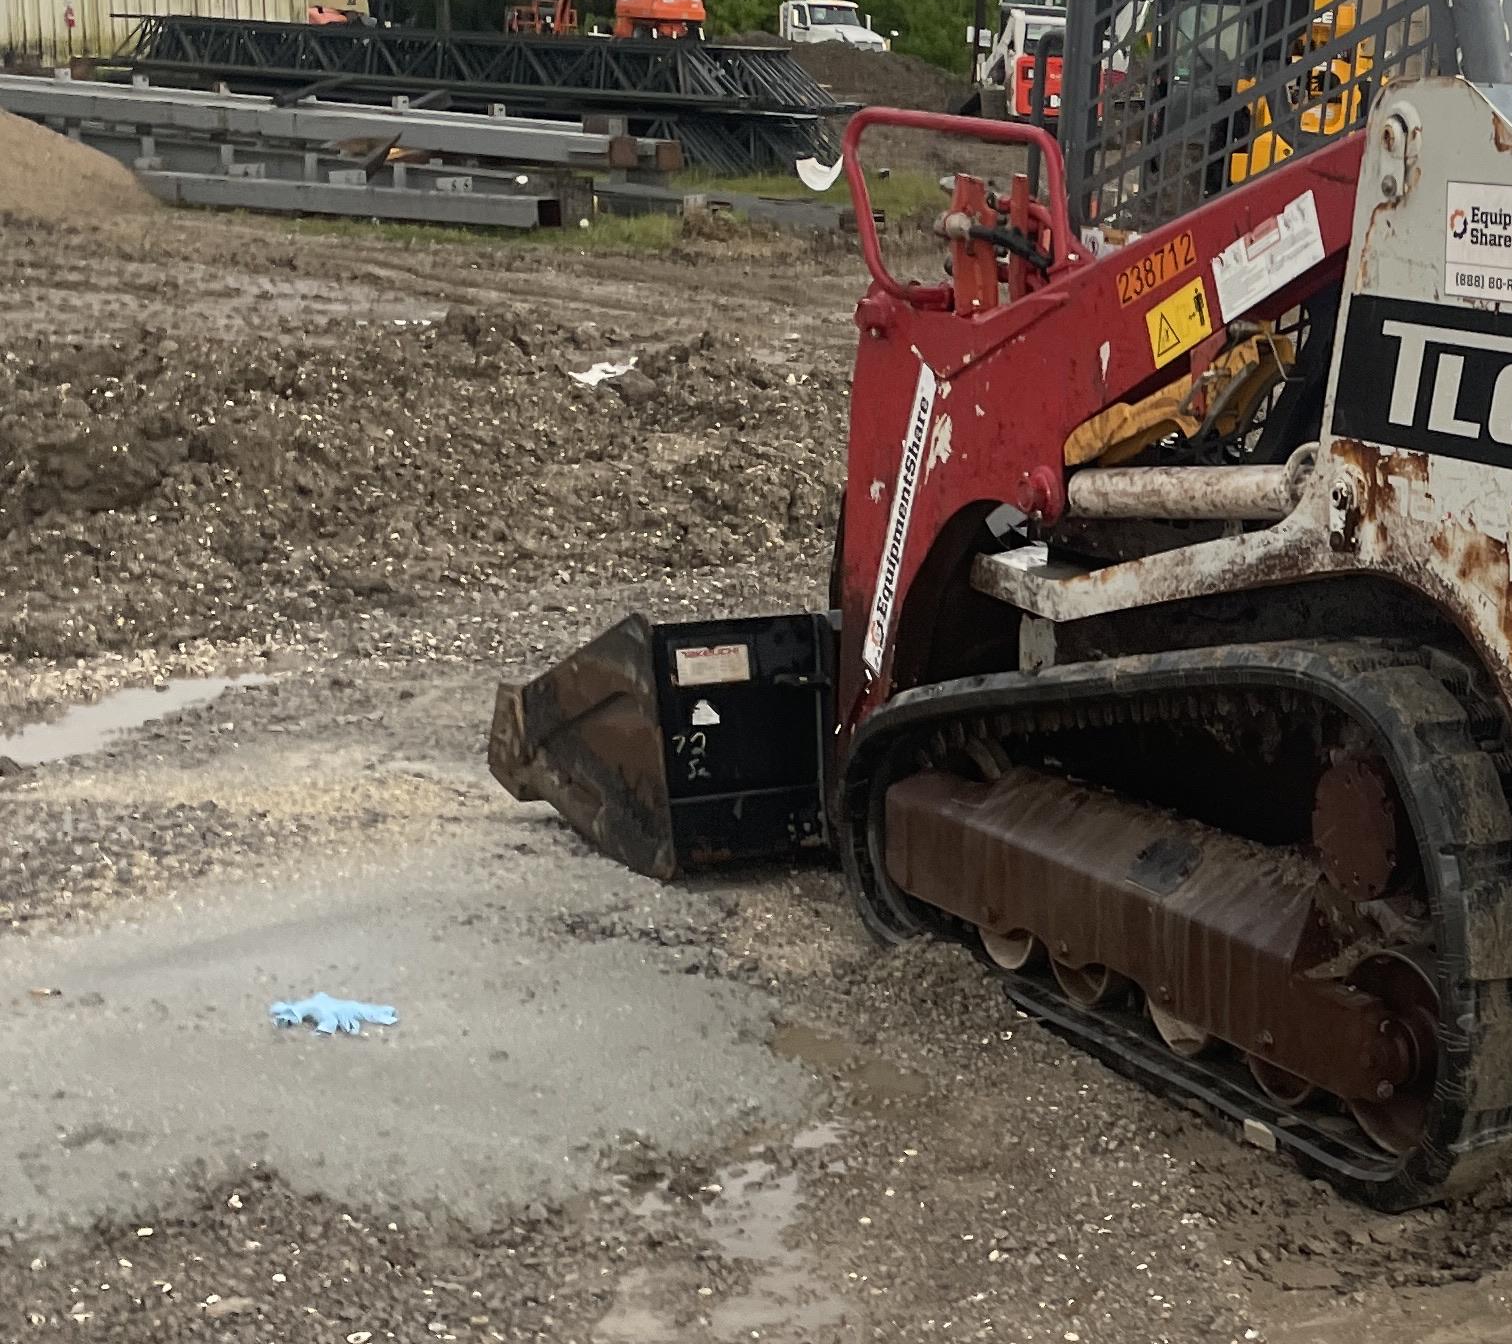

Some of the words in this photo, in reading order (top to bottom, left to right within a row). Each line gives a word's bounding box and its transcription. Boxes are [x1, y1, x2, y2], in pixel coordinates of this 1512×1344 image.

[1470, 228, 1512, 248] Share
[1118, 233, 1196, 304] 238712
[1455, 271, 1485, 289] (888)
[876, 396, 930, 614] EquipmentShare
